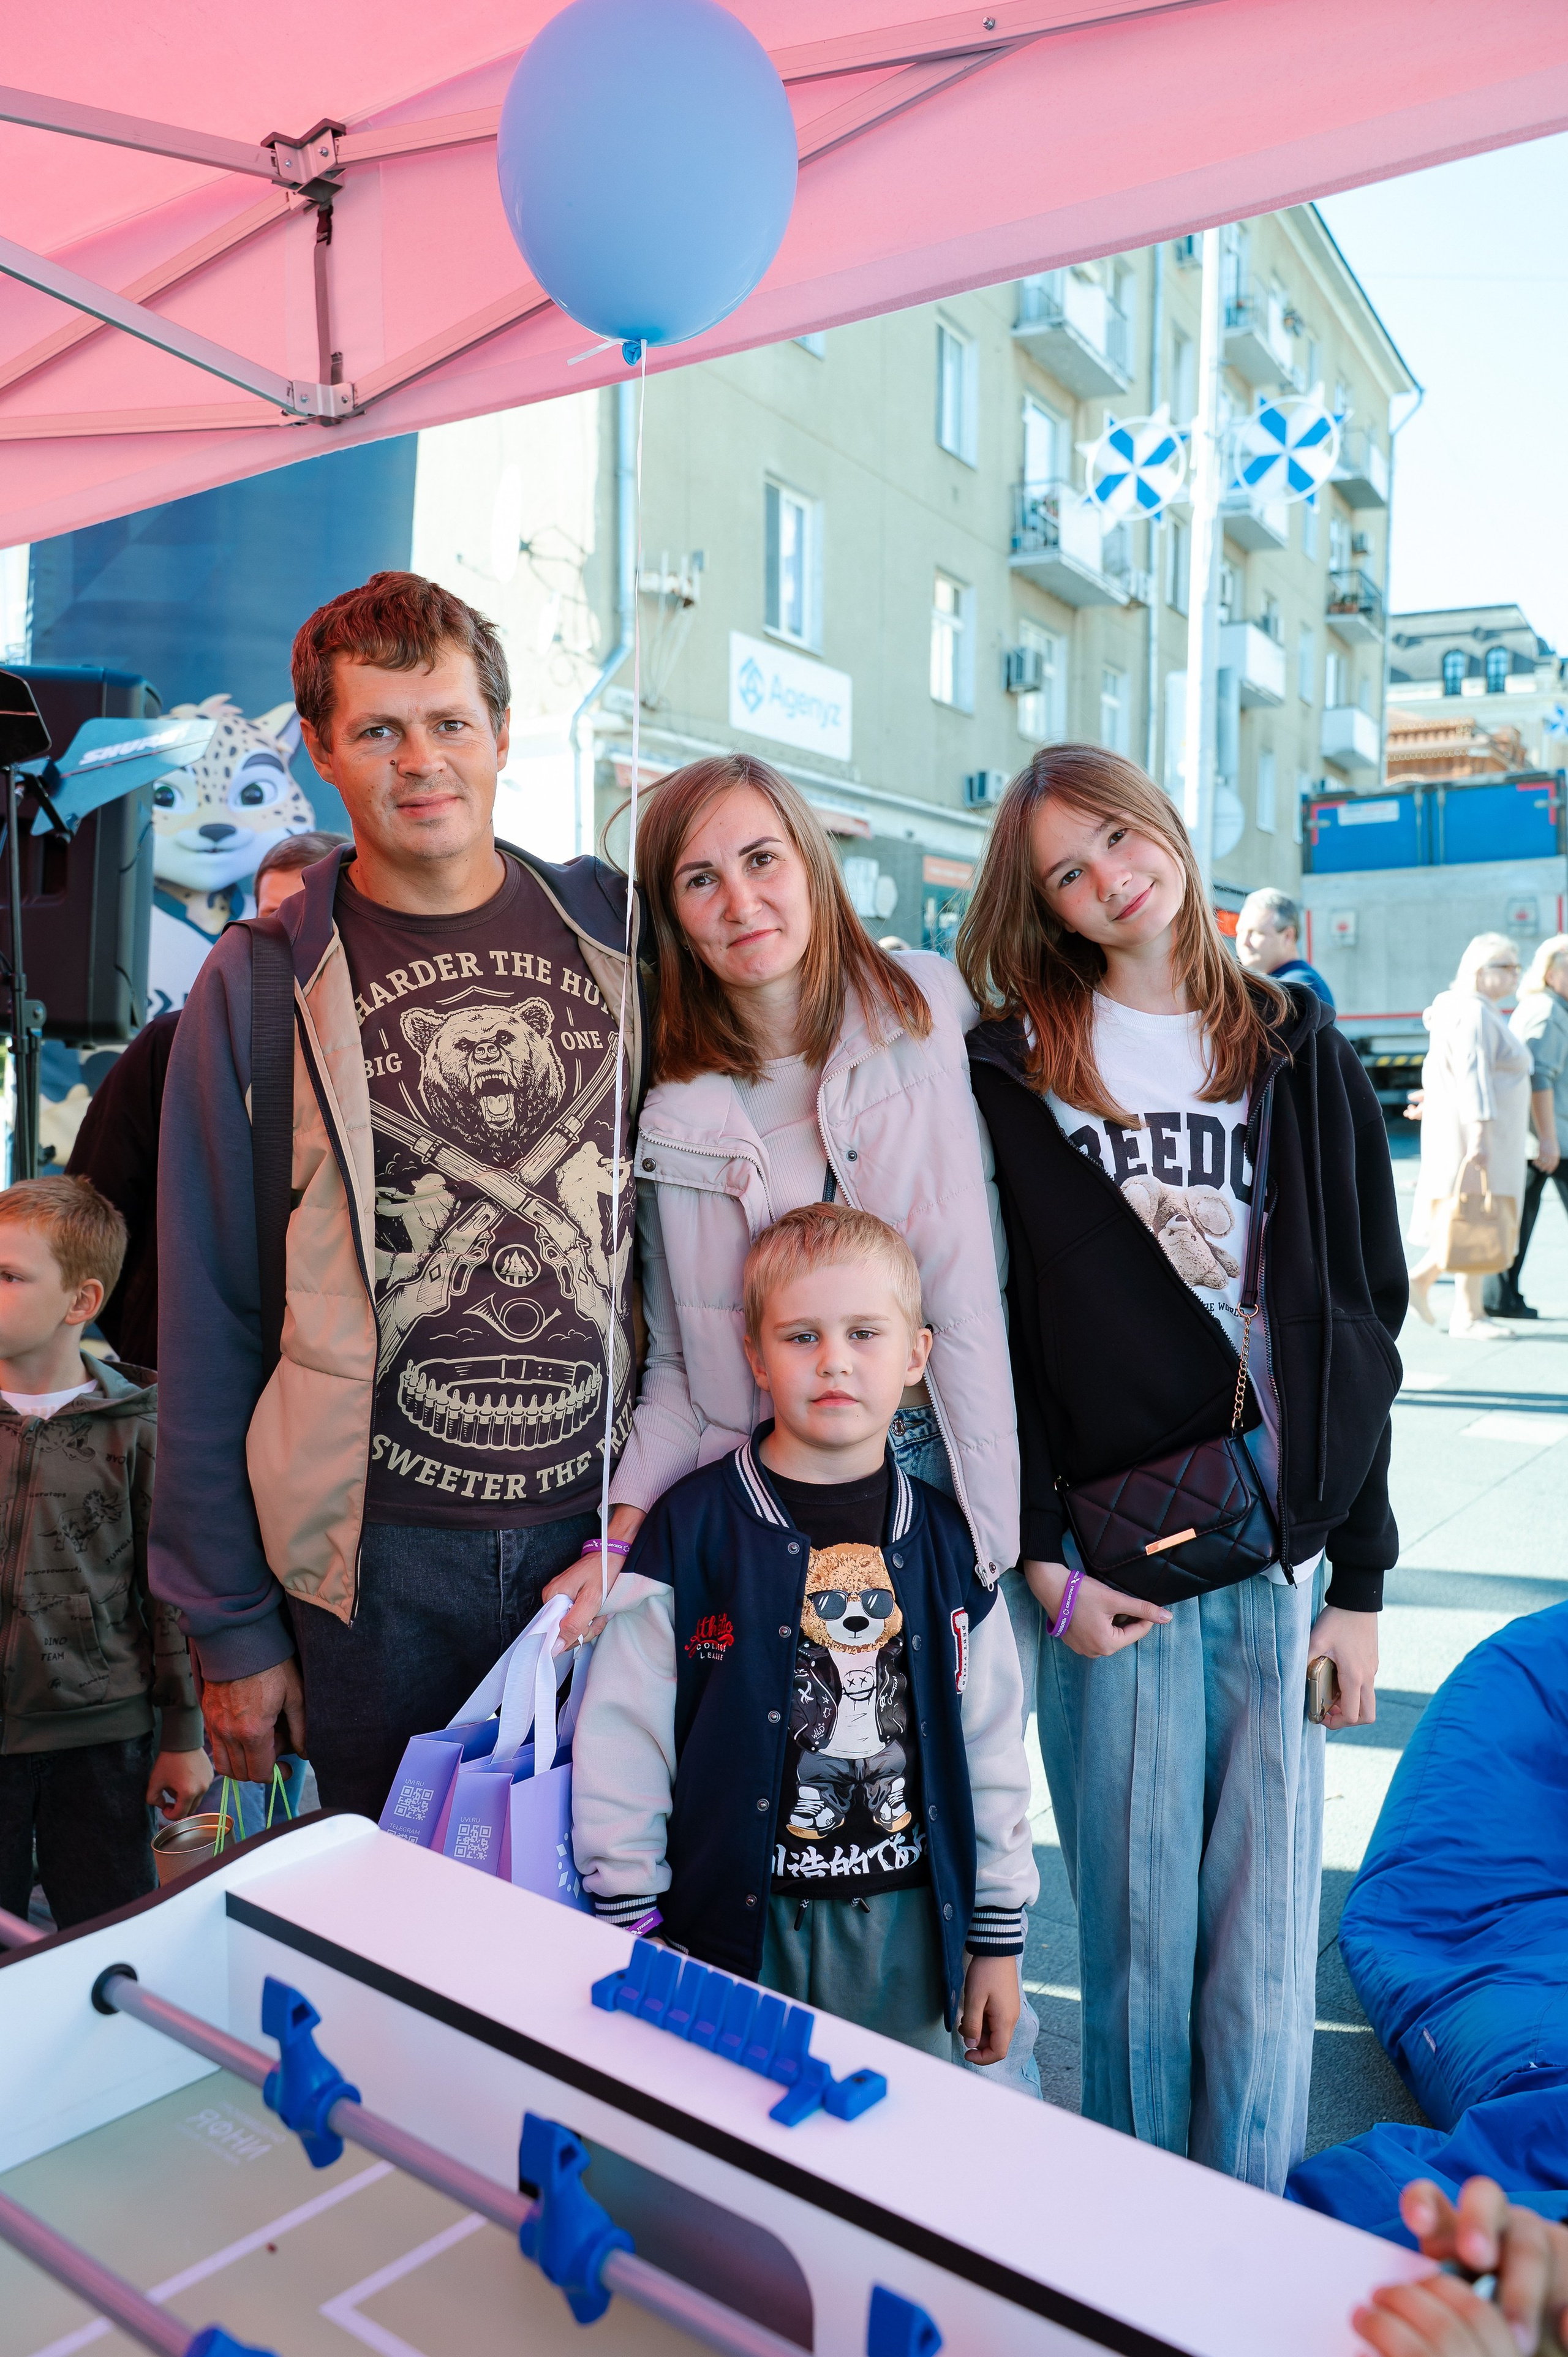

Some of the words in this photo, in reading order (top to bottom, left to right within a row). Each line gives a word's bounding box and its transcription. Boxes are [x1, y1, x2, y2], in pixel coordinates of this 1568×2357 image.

[768, 674, 841, 729] Agenyz
[355, 952, 483, 1027] HARDER
[489, 951, 552, 985] THE
[560, 967, 614, 1020] HU
[364, 1052, 402, 1079] BIG
[560, 1030, 603, 1050] ONE
[372, 1434, 527, 1500] SWEETER
[536, 1450, 592, 1493] THE
[44, 1636, 68, 1646] DINO
[40, 1651, 65, 1662] TEAM
[405, 1778, 425, 1787] UVI.RU
[389, 1822, 421, 1836] TELEGRAM
[636, 1917, 654, 1931] ТРИКОЛОР
